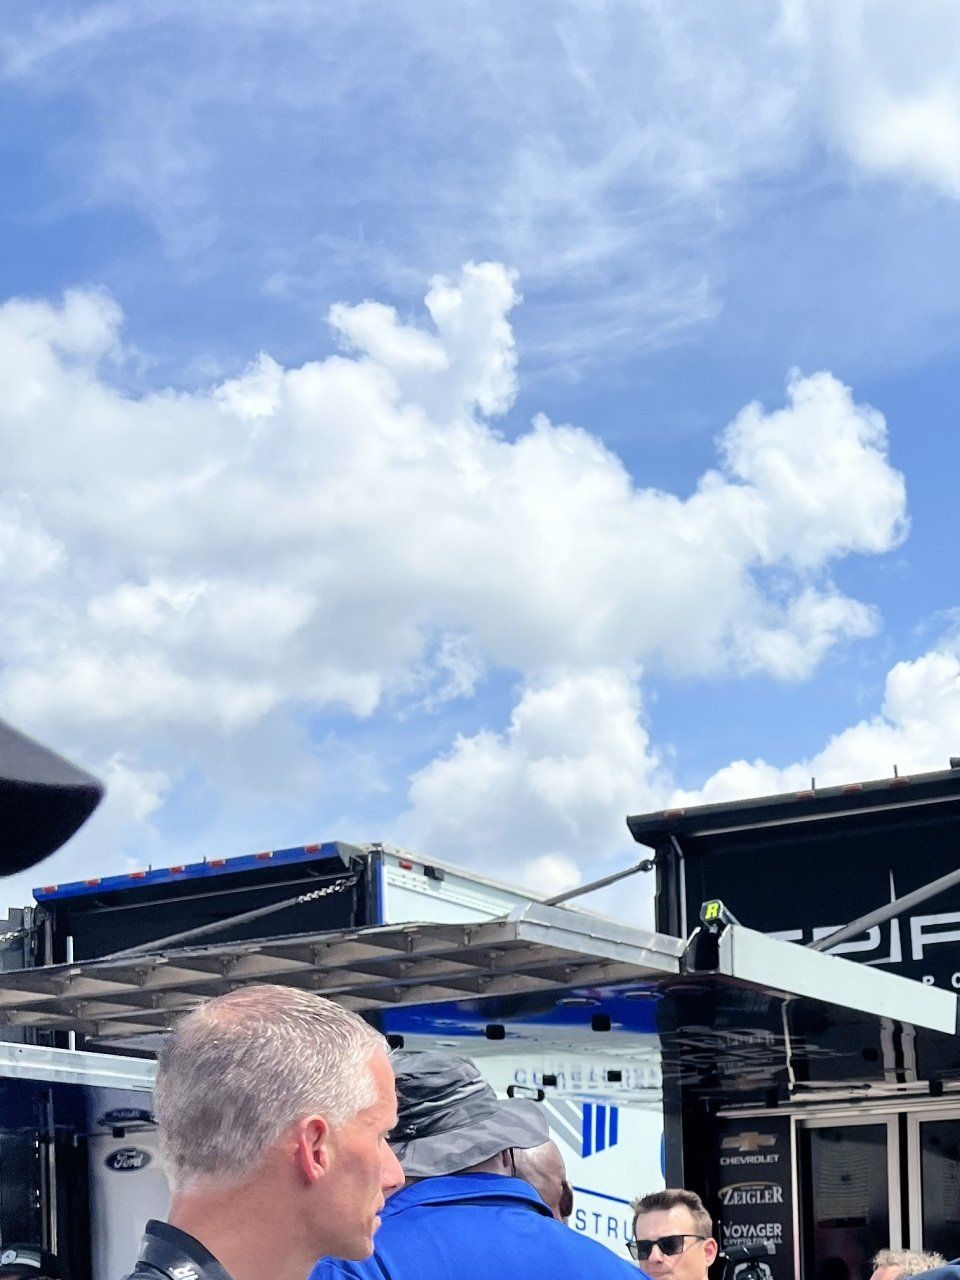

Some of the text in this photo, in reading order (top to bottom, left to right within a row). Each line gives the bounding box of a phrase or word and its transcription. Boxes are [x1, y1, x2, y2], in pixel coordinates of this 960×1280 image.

[114, 1151, 144, 1168] Ford
[720, 1154, 780, 1166] CHEVROLET
[723, 1186, 783, 1205] ZEIGLER
[575, 1208, 634, 1243] STRU
[723, 1223, 782, 1238] VOYAGER
